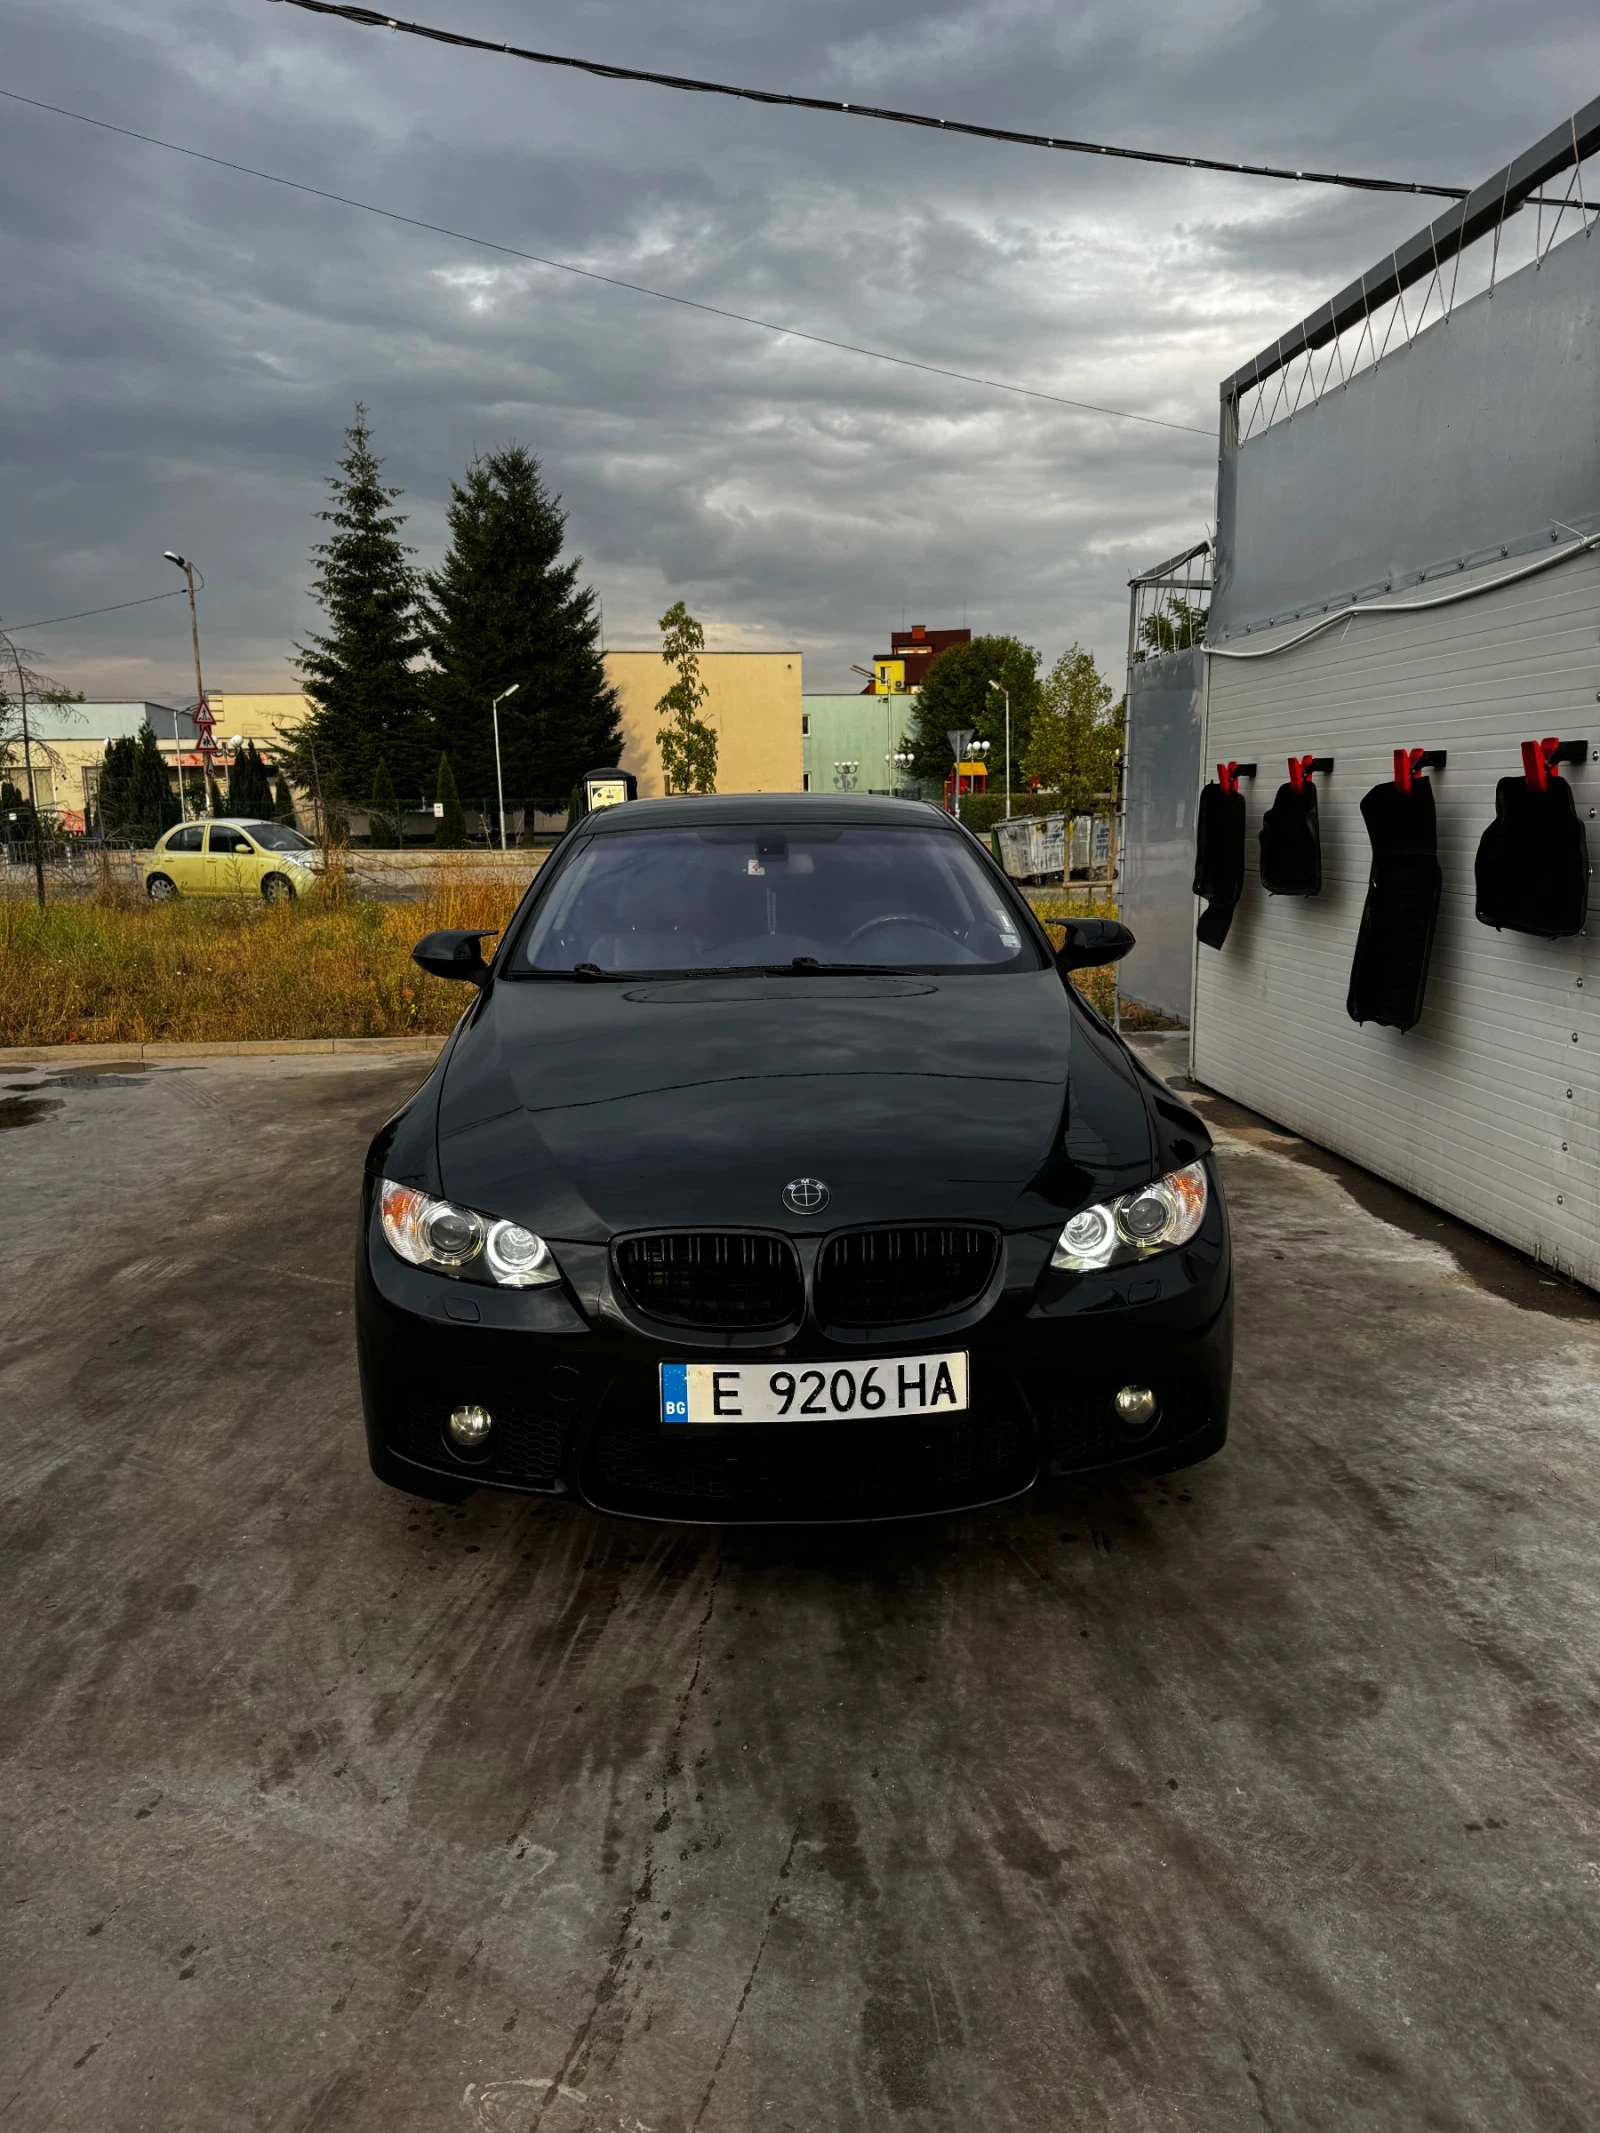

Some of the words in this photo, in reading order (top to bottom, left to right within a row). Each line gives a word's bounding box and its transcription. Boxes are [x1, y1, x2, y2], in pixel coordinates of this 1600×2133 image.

[787, 1178, 825, 1190] BMW
[712, 1371, 743, 1416] E
[769, 1366, 886, 1415] 9206
[897, 1361, 957, 1409] HA
[666, 1401, 686, 1415] BG
